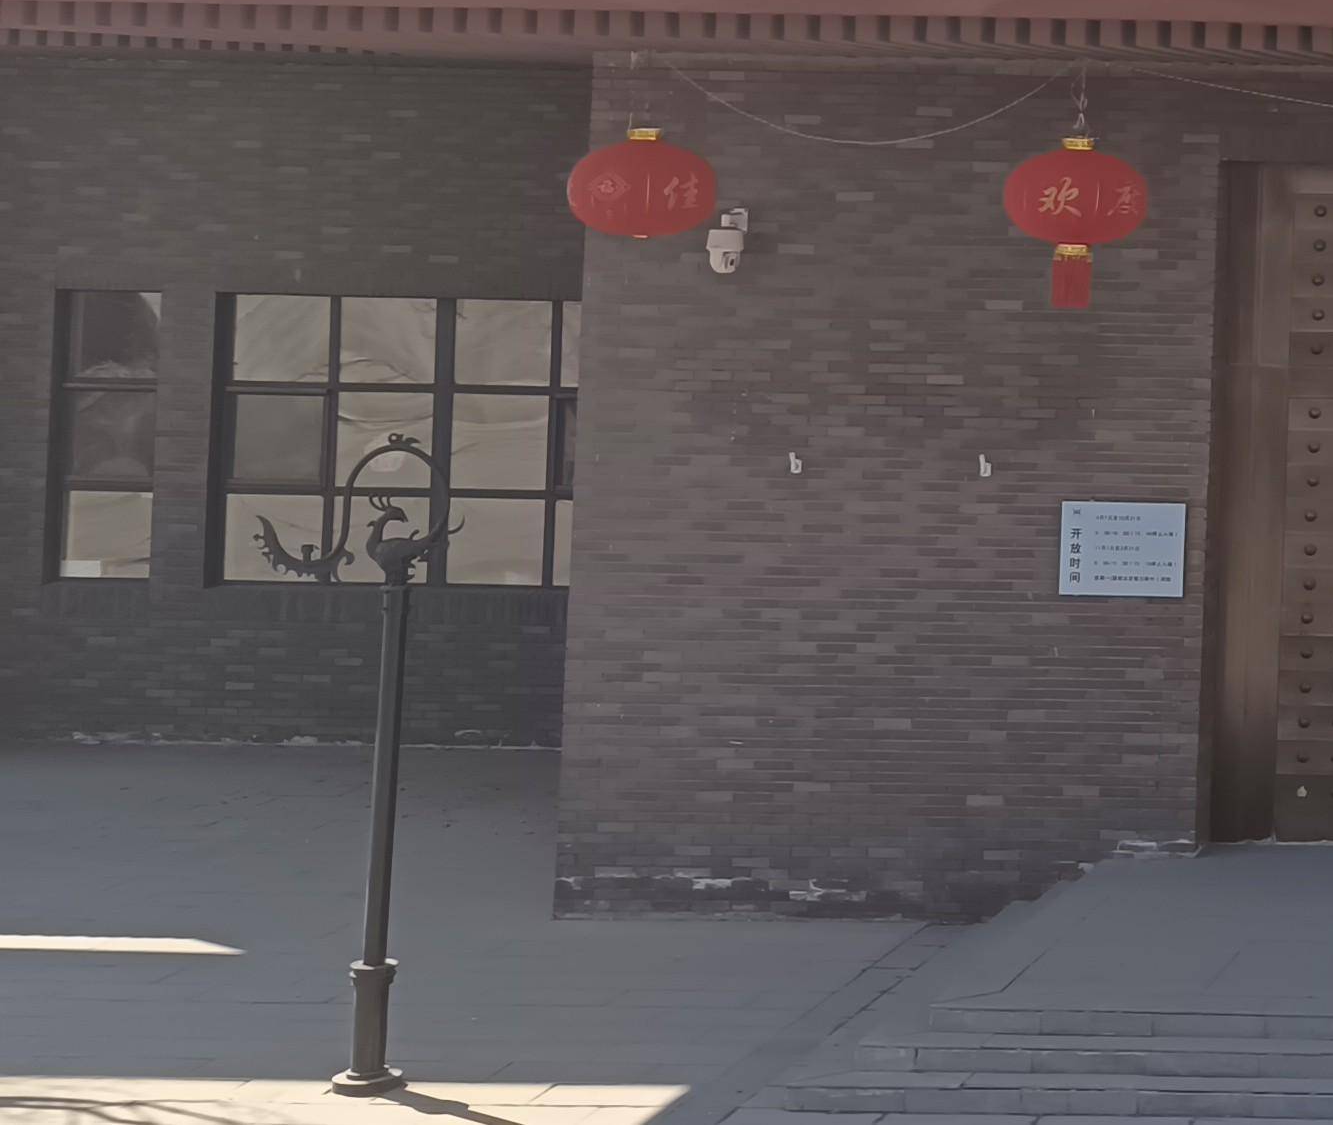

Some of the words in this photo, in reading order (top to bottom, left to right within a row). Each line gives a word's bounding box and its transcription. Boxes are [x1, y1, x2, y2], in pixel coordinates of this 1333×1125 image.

[663, 173, 699, 211] 佳
[1069, 528, 1082, 583] 开放时间
